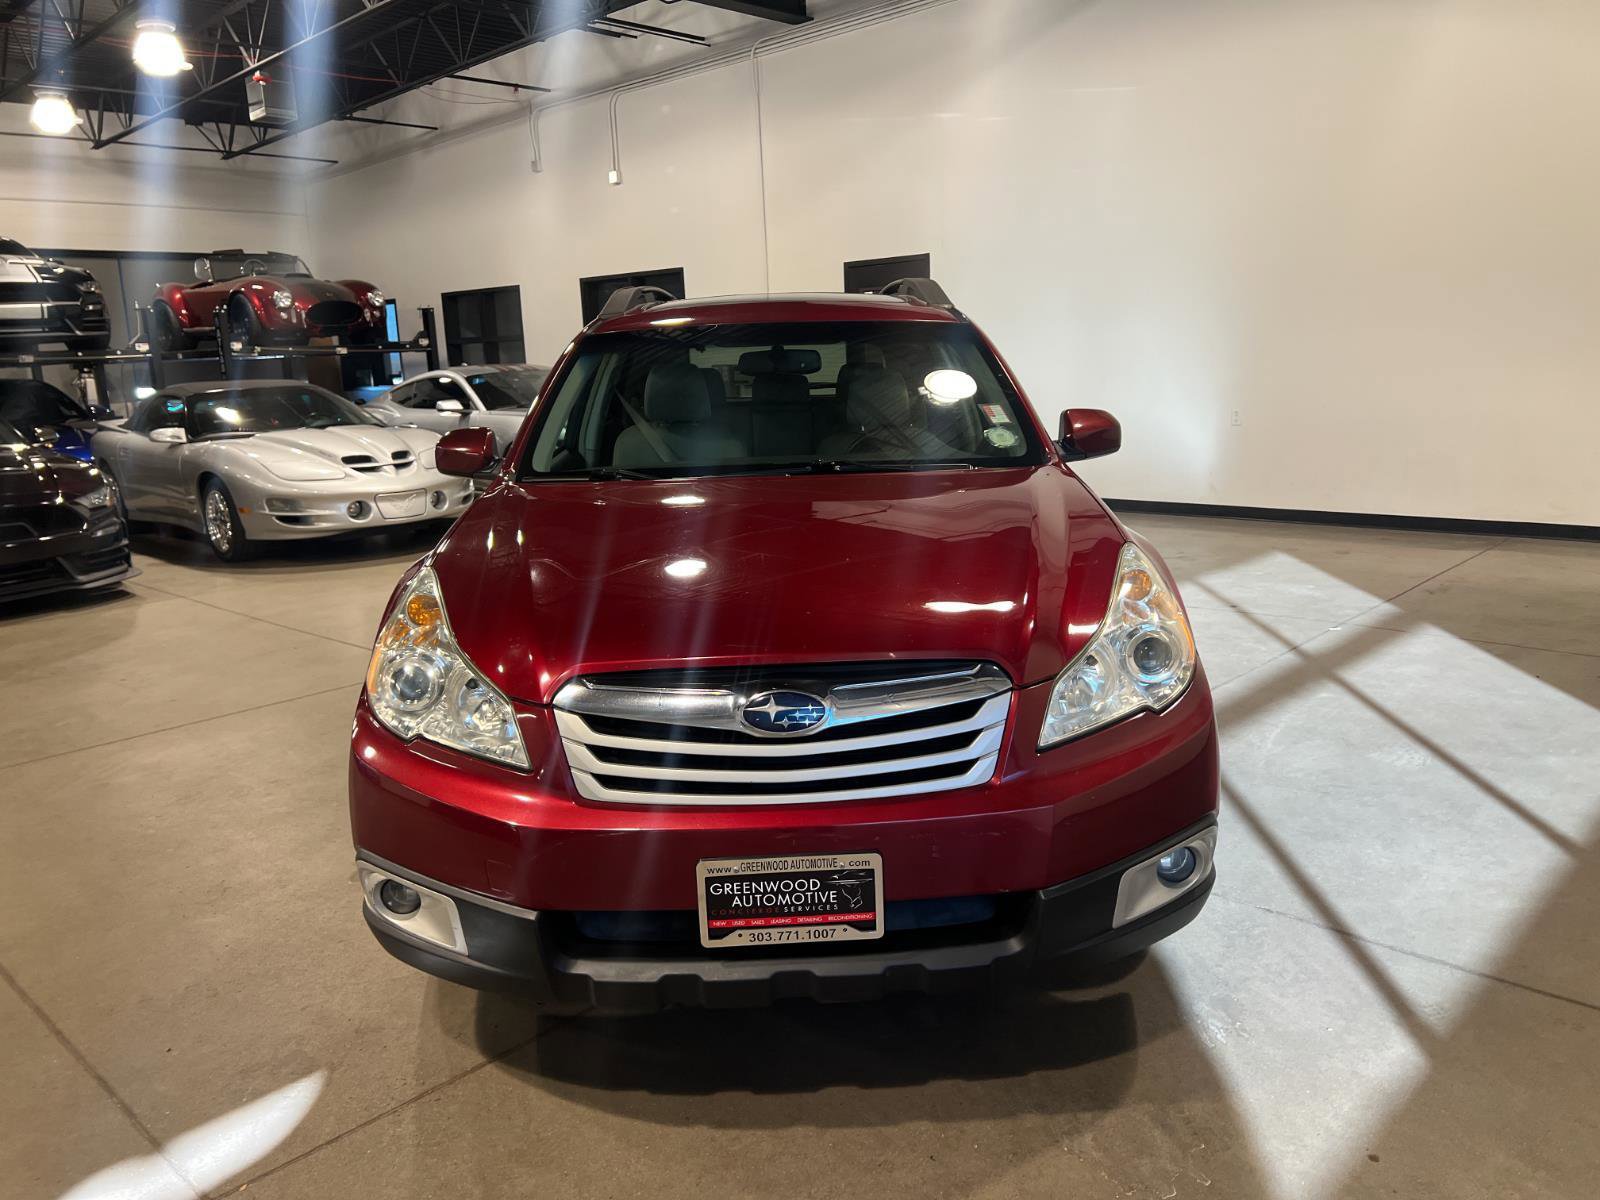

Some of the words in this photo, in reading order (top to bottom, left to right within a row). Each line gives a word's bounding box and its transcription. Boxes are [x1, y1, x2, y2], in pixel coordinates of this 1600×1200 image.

[740, 860, 789, 872] GREENWOOD
[790, 858, 838, 870] AUTOMOTIVE
[848, 859, 871, 867] com
[710, 879, 821, 895] GREENWOOD
[731, 891, 838, 908] AUTOMOTIVE
[784, 904, 838, 912] SERVICES
[748, 929, 837, 942] 303.771.1007
